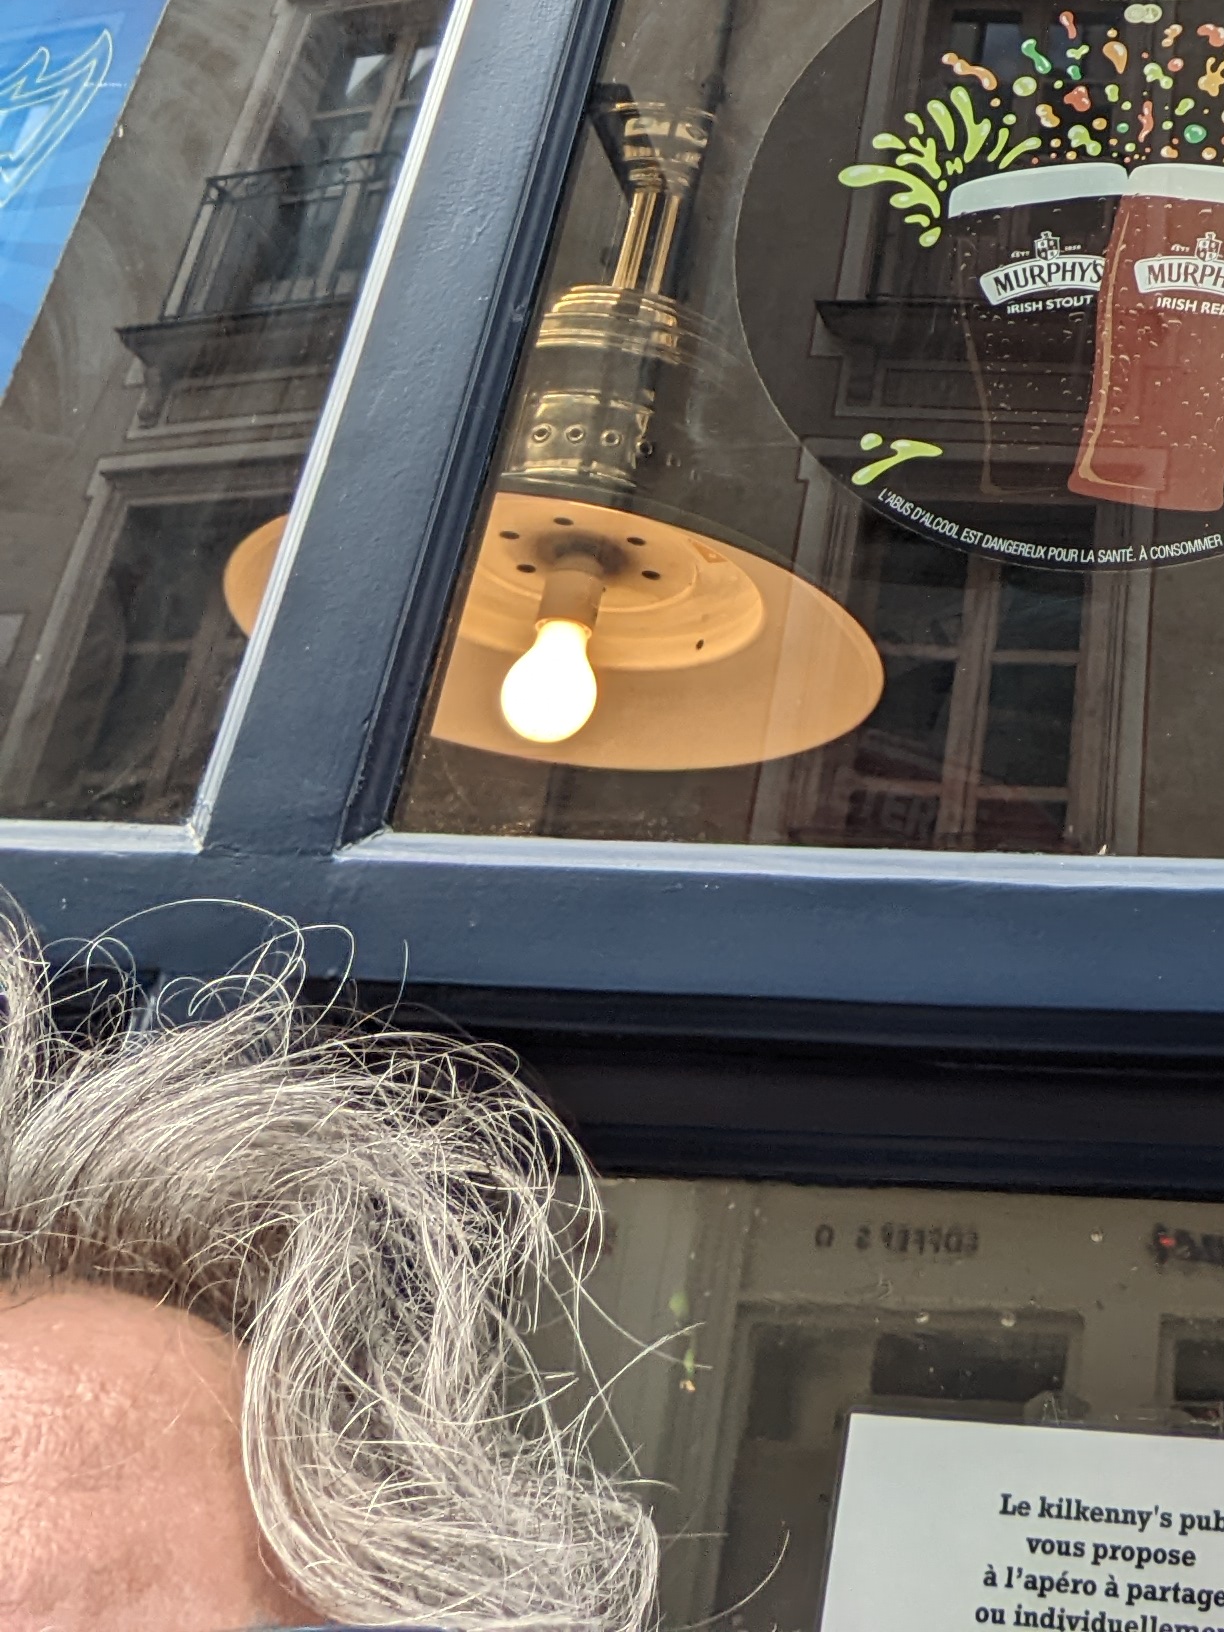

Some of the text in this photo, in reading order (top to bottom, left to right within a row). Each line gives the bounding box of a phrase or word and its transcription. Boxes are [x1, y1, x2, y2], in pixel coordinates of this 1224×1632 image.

[1006, 294, 1094, 315] IRISH STOUT
[1156, 297, 1198, 312] IRISH
[877, 487, 912, 517] L'ABUS
[911, 506, 959, 539] D'ALCOOL
[960, 527, 984, 546] EST
[982, 534, 1046, 560] DANGEREUX
[1047, 547, 1078, 563] POUR
[1080, 549, 1095, 563] LA
[1097, 546, 1136, 563] SANTÉ.
[1139, 544, 1148, 561] À
[1150, 533, 1224, 560] CONSOMMER
[999, 1493, 1031, 1517] Le
[1037, 1495, 1173, 1533] kilkenny's
[1026, 1536, 1197, 1569] vous propose
[982, 1563, 998, 1587] à
[1104, 1574, 1119, 1598] à
[974, 1606, 1006, 1625] ou
